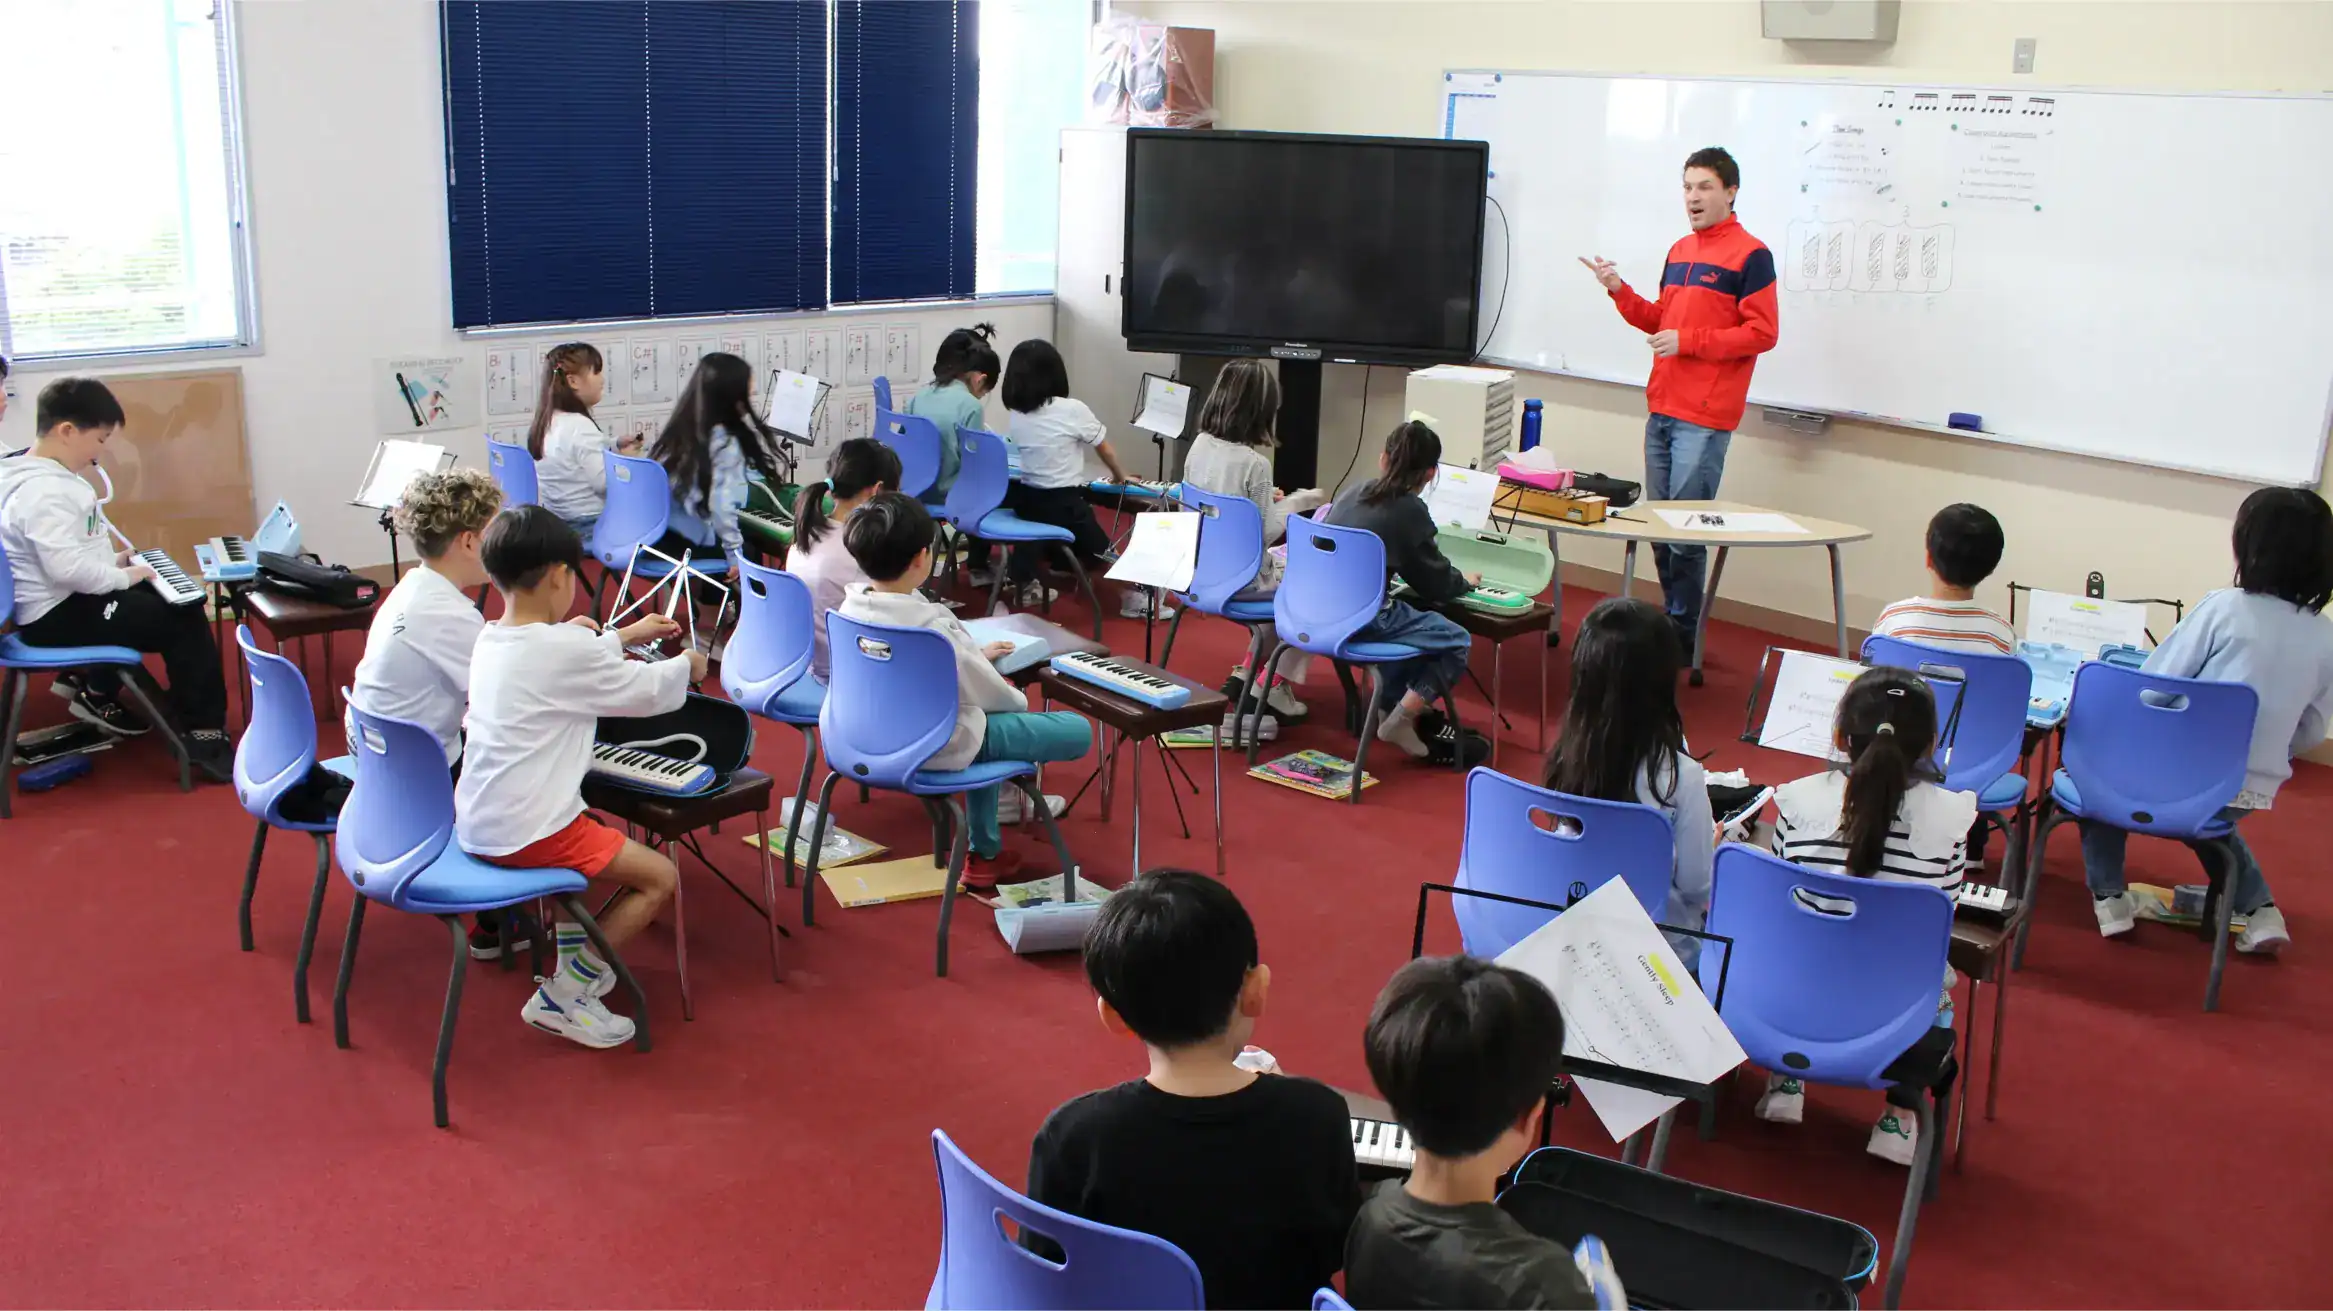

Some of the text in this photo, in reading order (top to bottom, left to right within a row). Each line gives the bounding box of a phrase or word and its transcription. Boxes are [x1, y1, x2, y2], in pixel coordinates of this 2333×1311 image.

[808, 336, 815, 347] F
[888, 333, 896, 344] G
[1637, 954, 1675, 1006] Gently Sleep
